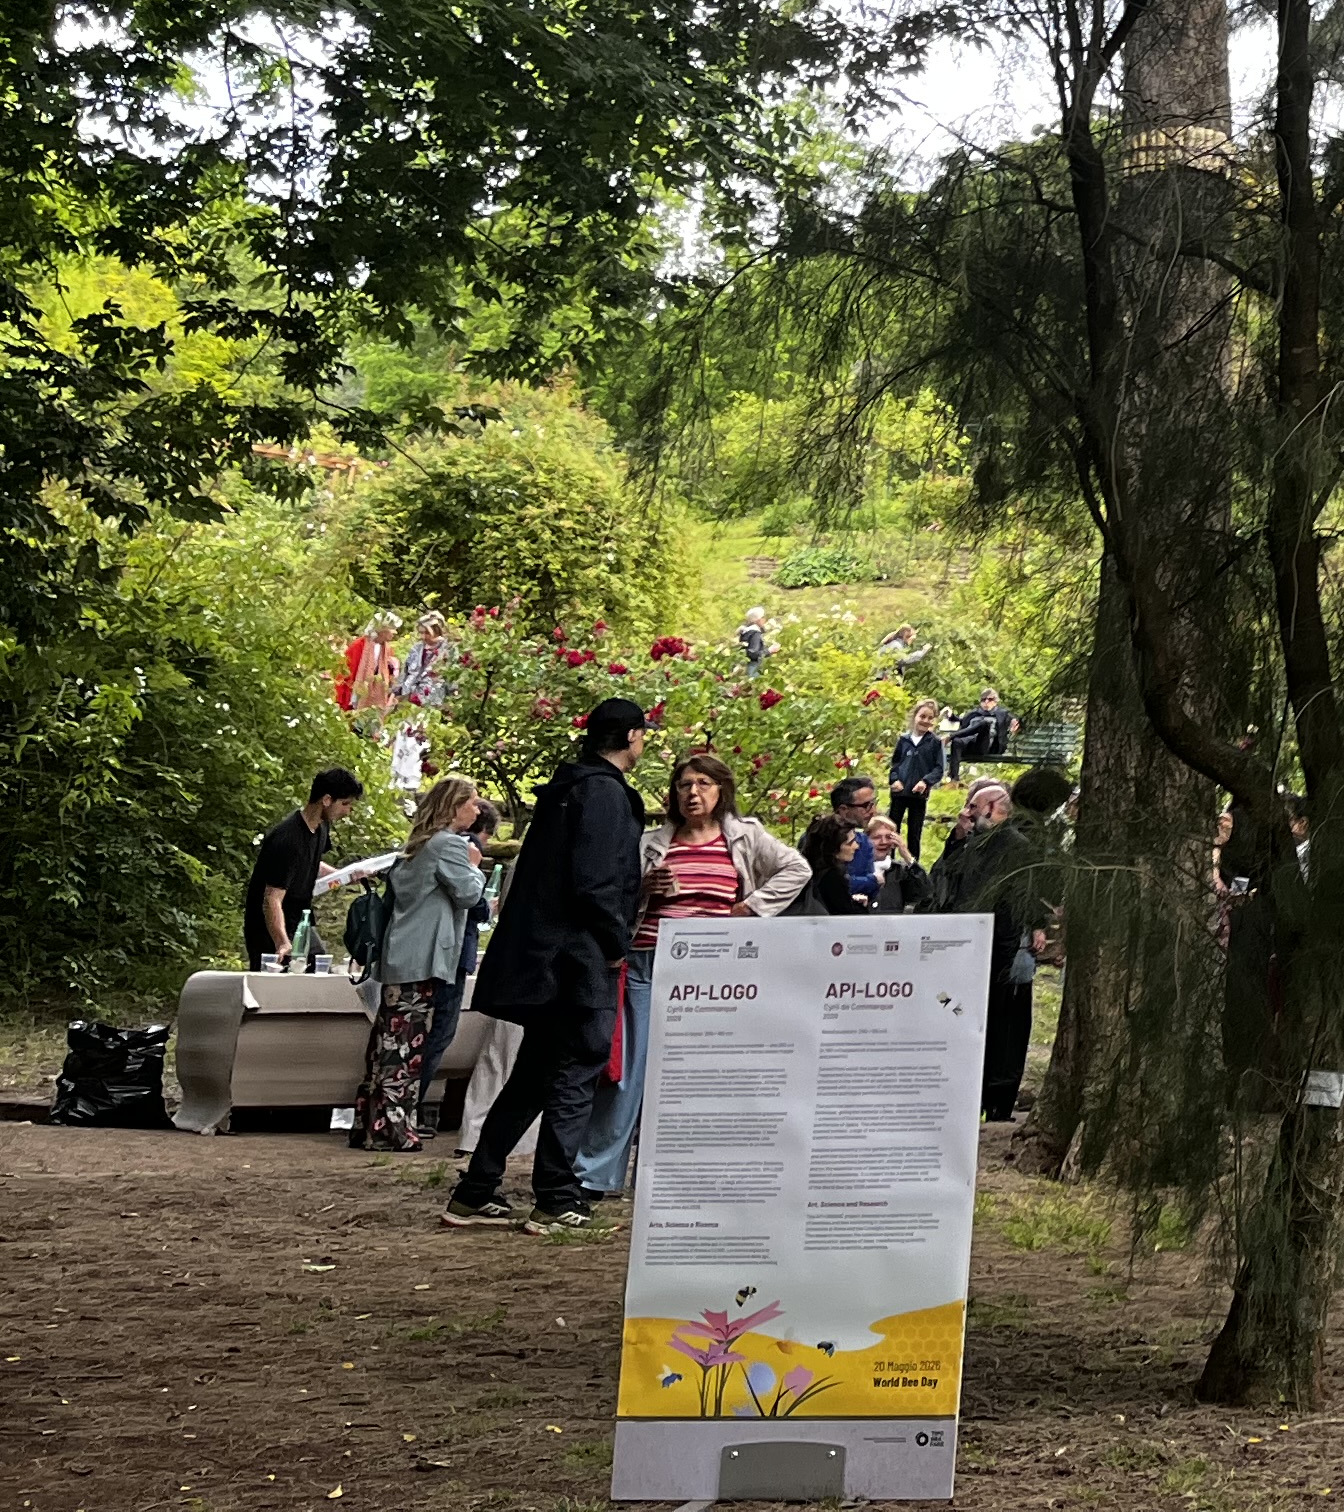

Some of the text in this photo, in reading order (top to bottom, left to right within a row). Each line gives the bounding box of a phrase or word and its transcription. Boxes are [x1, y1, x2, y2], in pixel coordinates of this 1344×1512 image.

[668, 984, 758, 1001] API-LOGO
[825, 982, 914, 999] API-LOGO
[874, 1361, 885, 1372] 20
[887, 1361, 918, 1374] Maggio
[873, 1376, 938, 1389] World Bee Day
